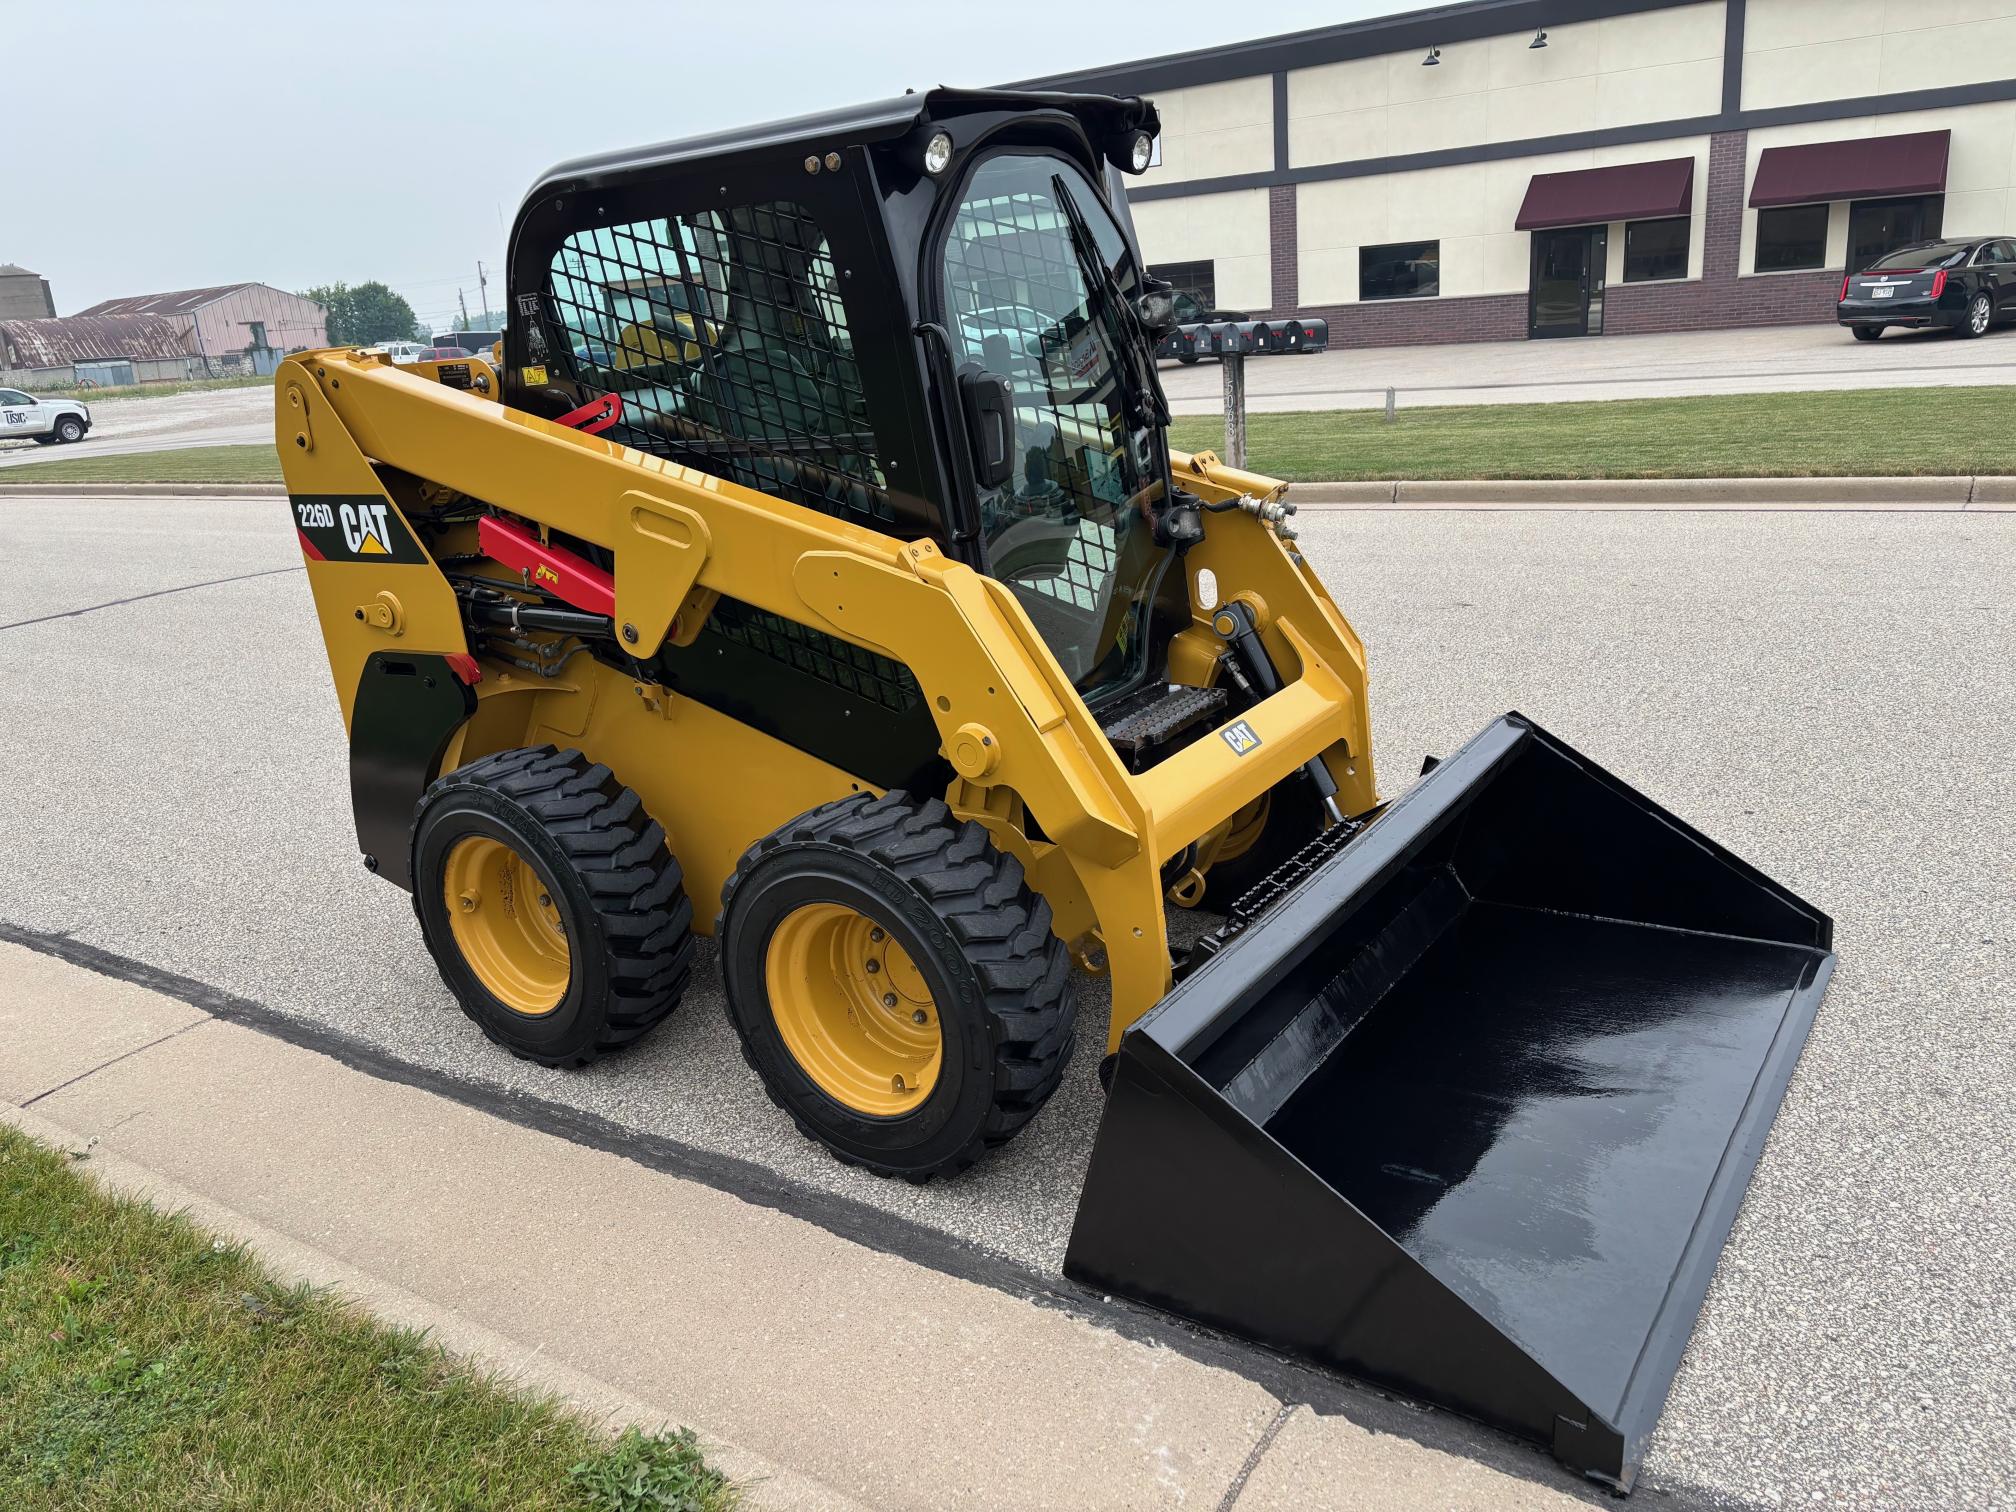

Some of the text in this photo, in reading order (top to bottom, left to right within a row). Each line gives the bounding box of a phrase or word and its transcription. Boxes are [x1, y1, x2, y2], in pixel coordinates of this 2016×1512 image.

[6, 412, 26, 424] USIC
[1226, 381, 1236, 436] 5068
[297, 504, 334, 528] 226D
[339, 503, 393, 554] CAT
[1224, 723, 1257, 752] CAT
